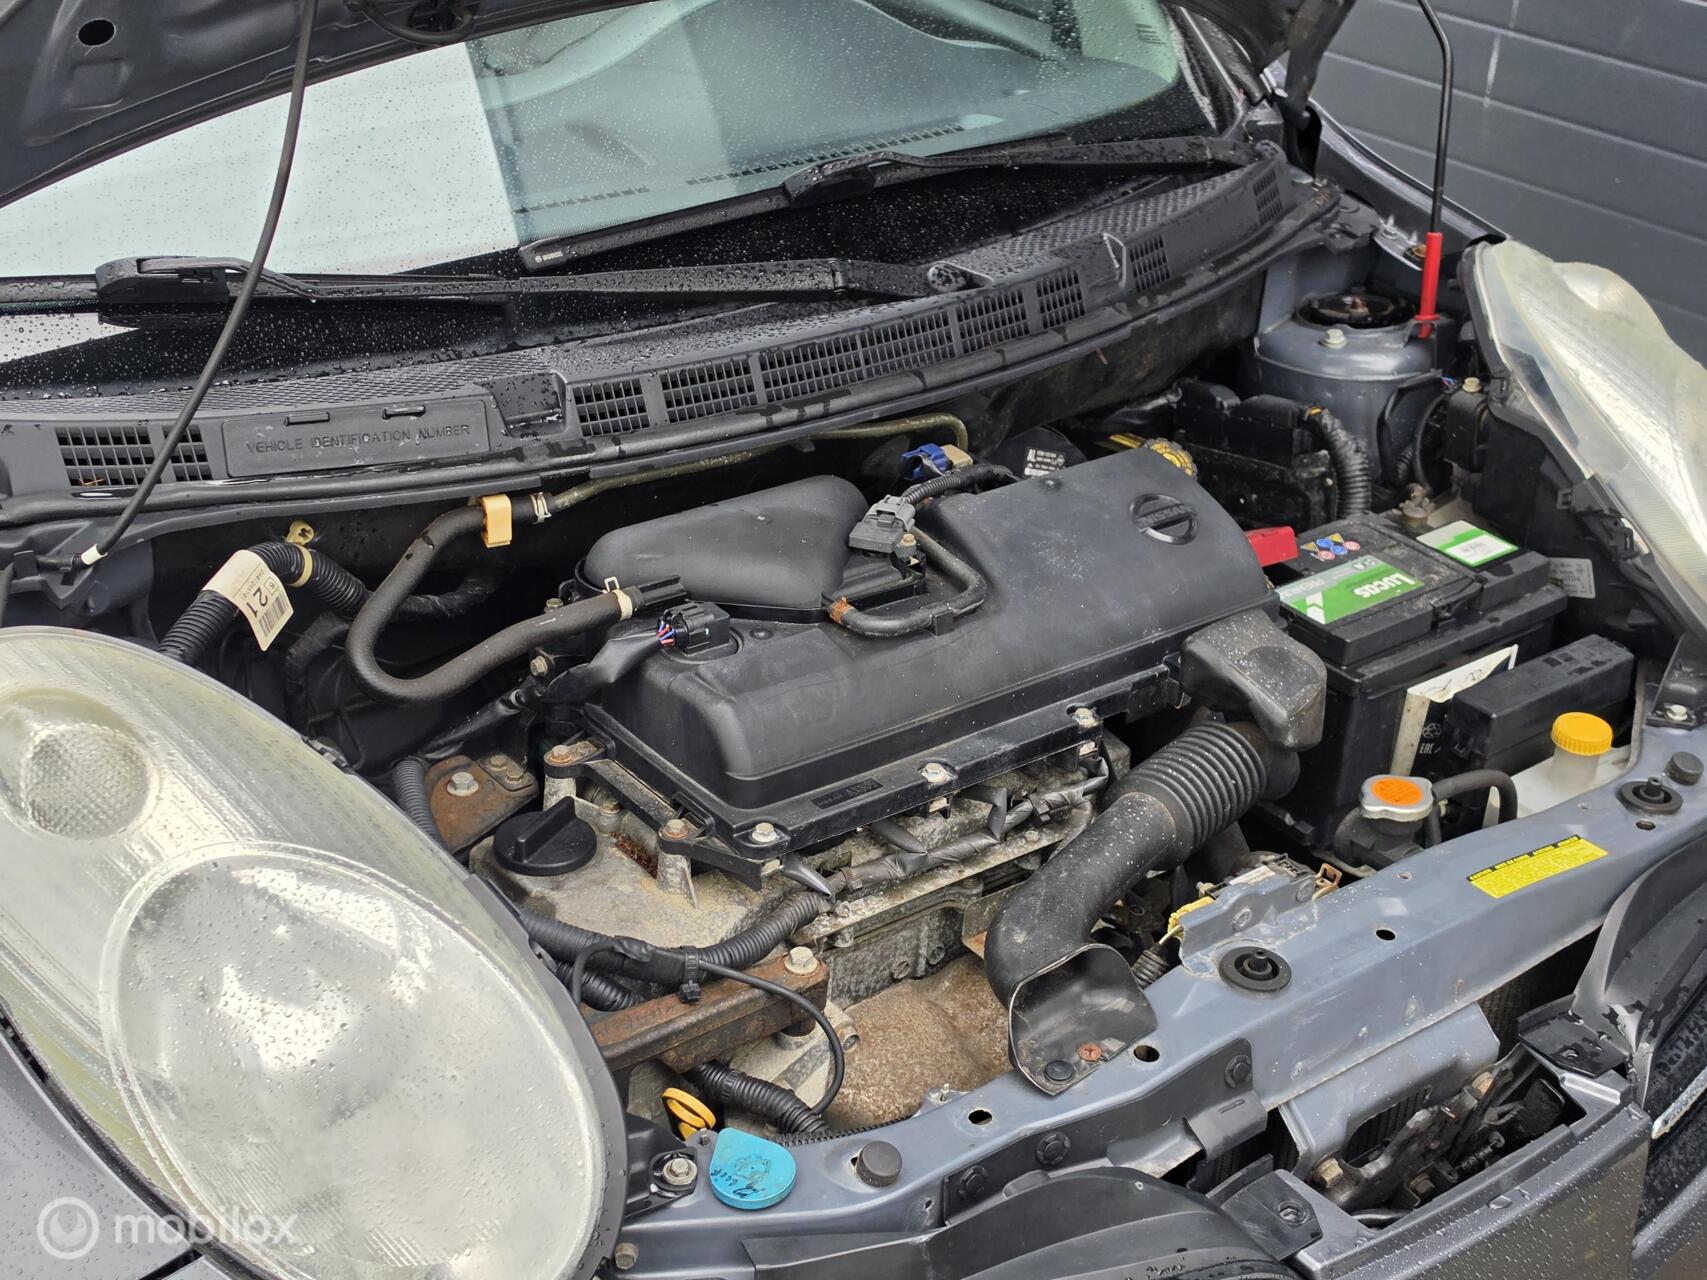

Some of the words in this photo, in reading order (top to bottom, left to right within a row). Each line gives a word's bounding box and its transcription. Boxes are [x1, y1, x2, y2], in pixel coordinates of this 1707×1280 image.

[246, 440, 303, 454] VEHICLE
[311, 430, 411, 449] IDENTIFICATION
[417, 424, 470, 442] NUMBER
[1138, 503, 1188, 527] NISSAN
[247, 586, 269, 618] 21
